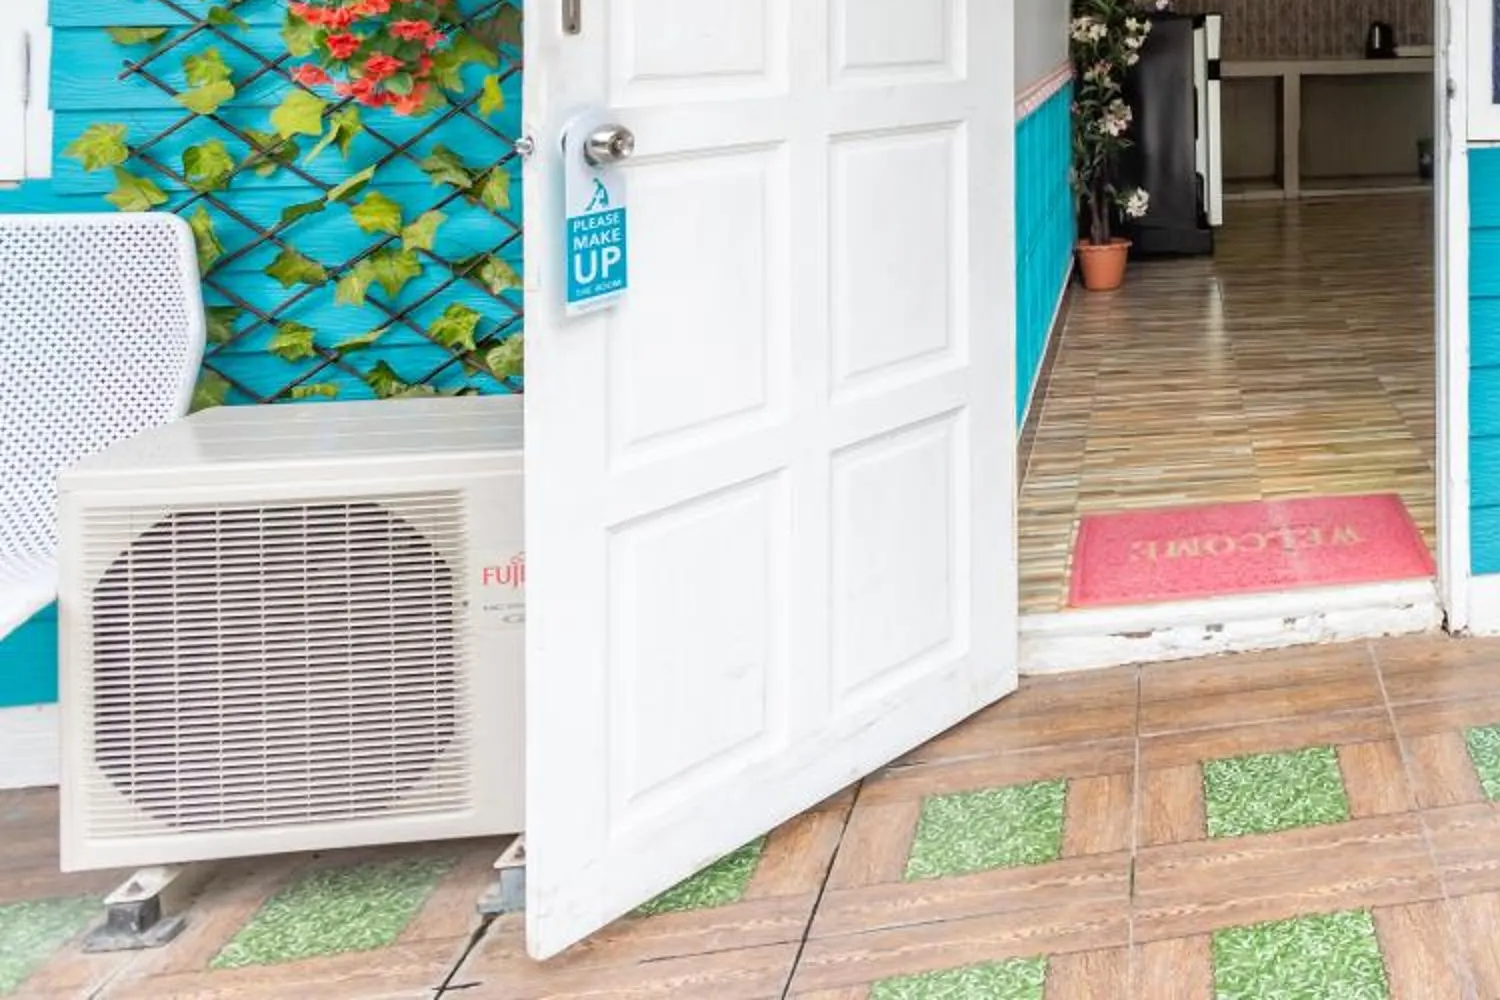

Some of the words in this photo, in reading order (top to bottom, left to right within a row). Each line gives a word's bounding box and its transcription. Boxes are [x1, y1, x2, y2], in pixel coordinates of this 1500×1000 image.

[573, 212, 621, 232] PLEASE
[573, 228, 621, 251] MAKE
[574, 246, 621, 284] UP
[1129, 522, 1366, 561] WELCOME
[483, 562, 525, 588] FUJI
